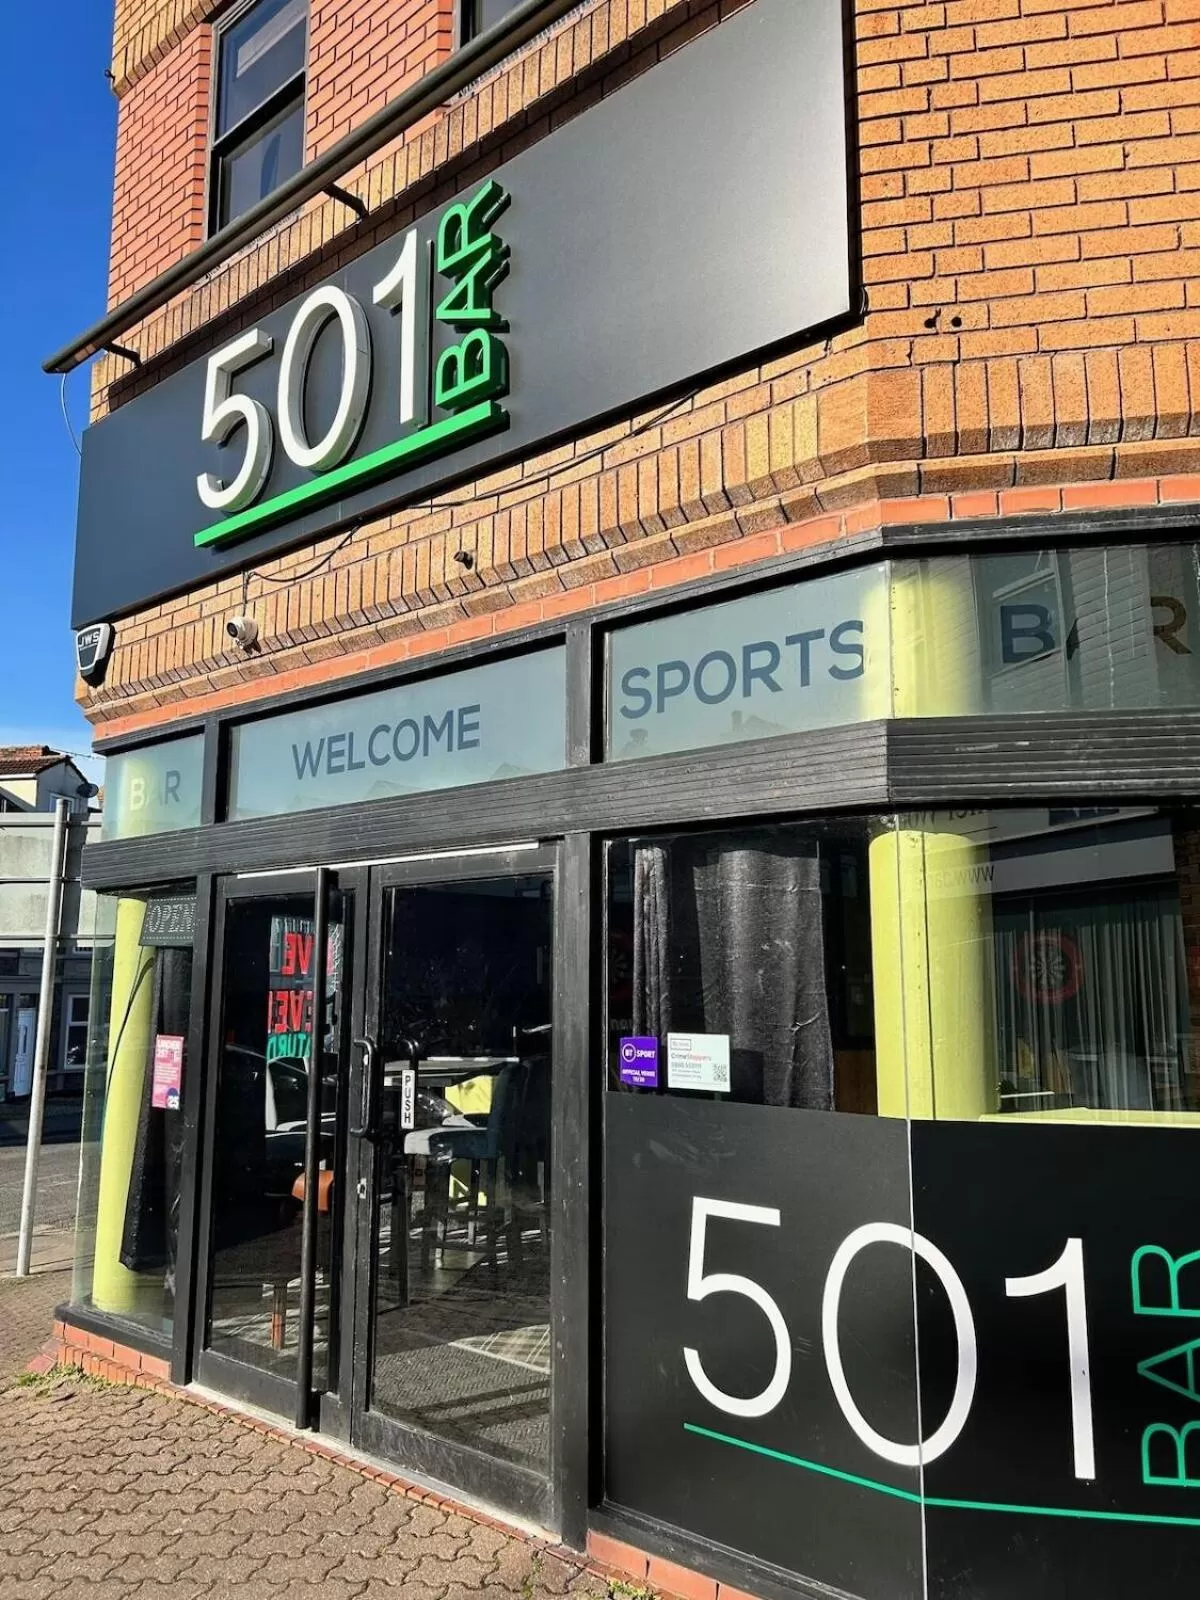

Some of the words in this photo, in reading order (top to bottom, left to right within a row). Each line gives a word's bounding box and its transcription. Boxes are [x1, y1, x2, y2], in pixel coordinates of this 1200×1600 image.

[197, 228, 426, 511] 501
[435, 180, 504, 409] BAR
[292, 704, 481, 780] WELCOME
[620, 620, 864, 720] SPORTS
[1000, 595, 1193, 664] BR
[404, 1074, 412, 1124] PUSH
[636, 1050, 656, 1058] SPORT
[684, 1196, 1096, 1480] 501
[1130, 1245, 1200, 1487] BAR
